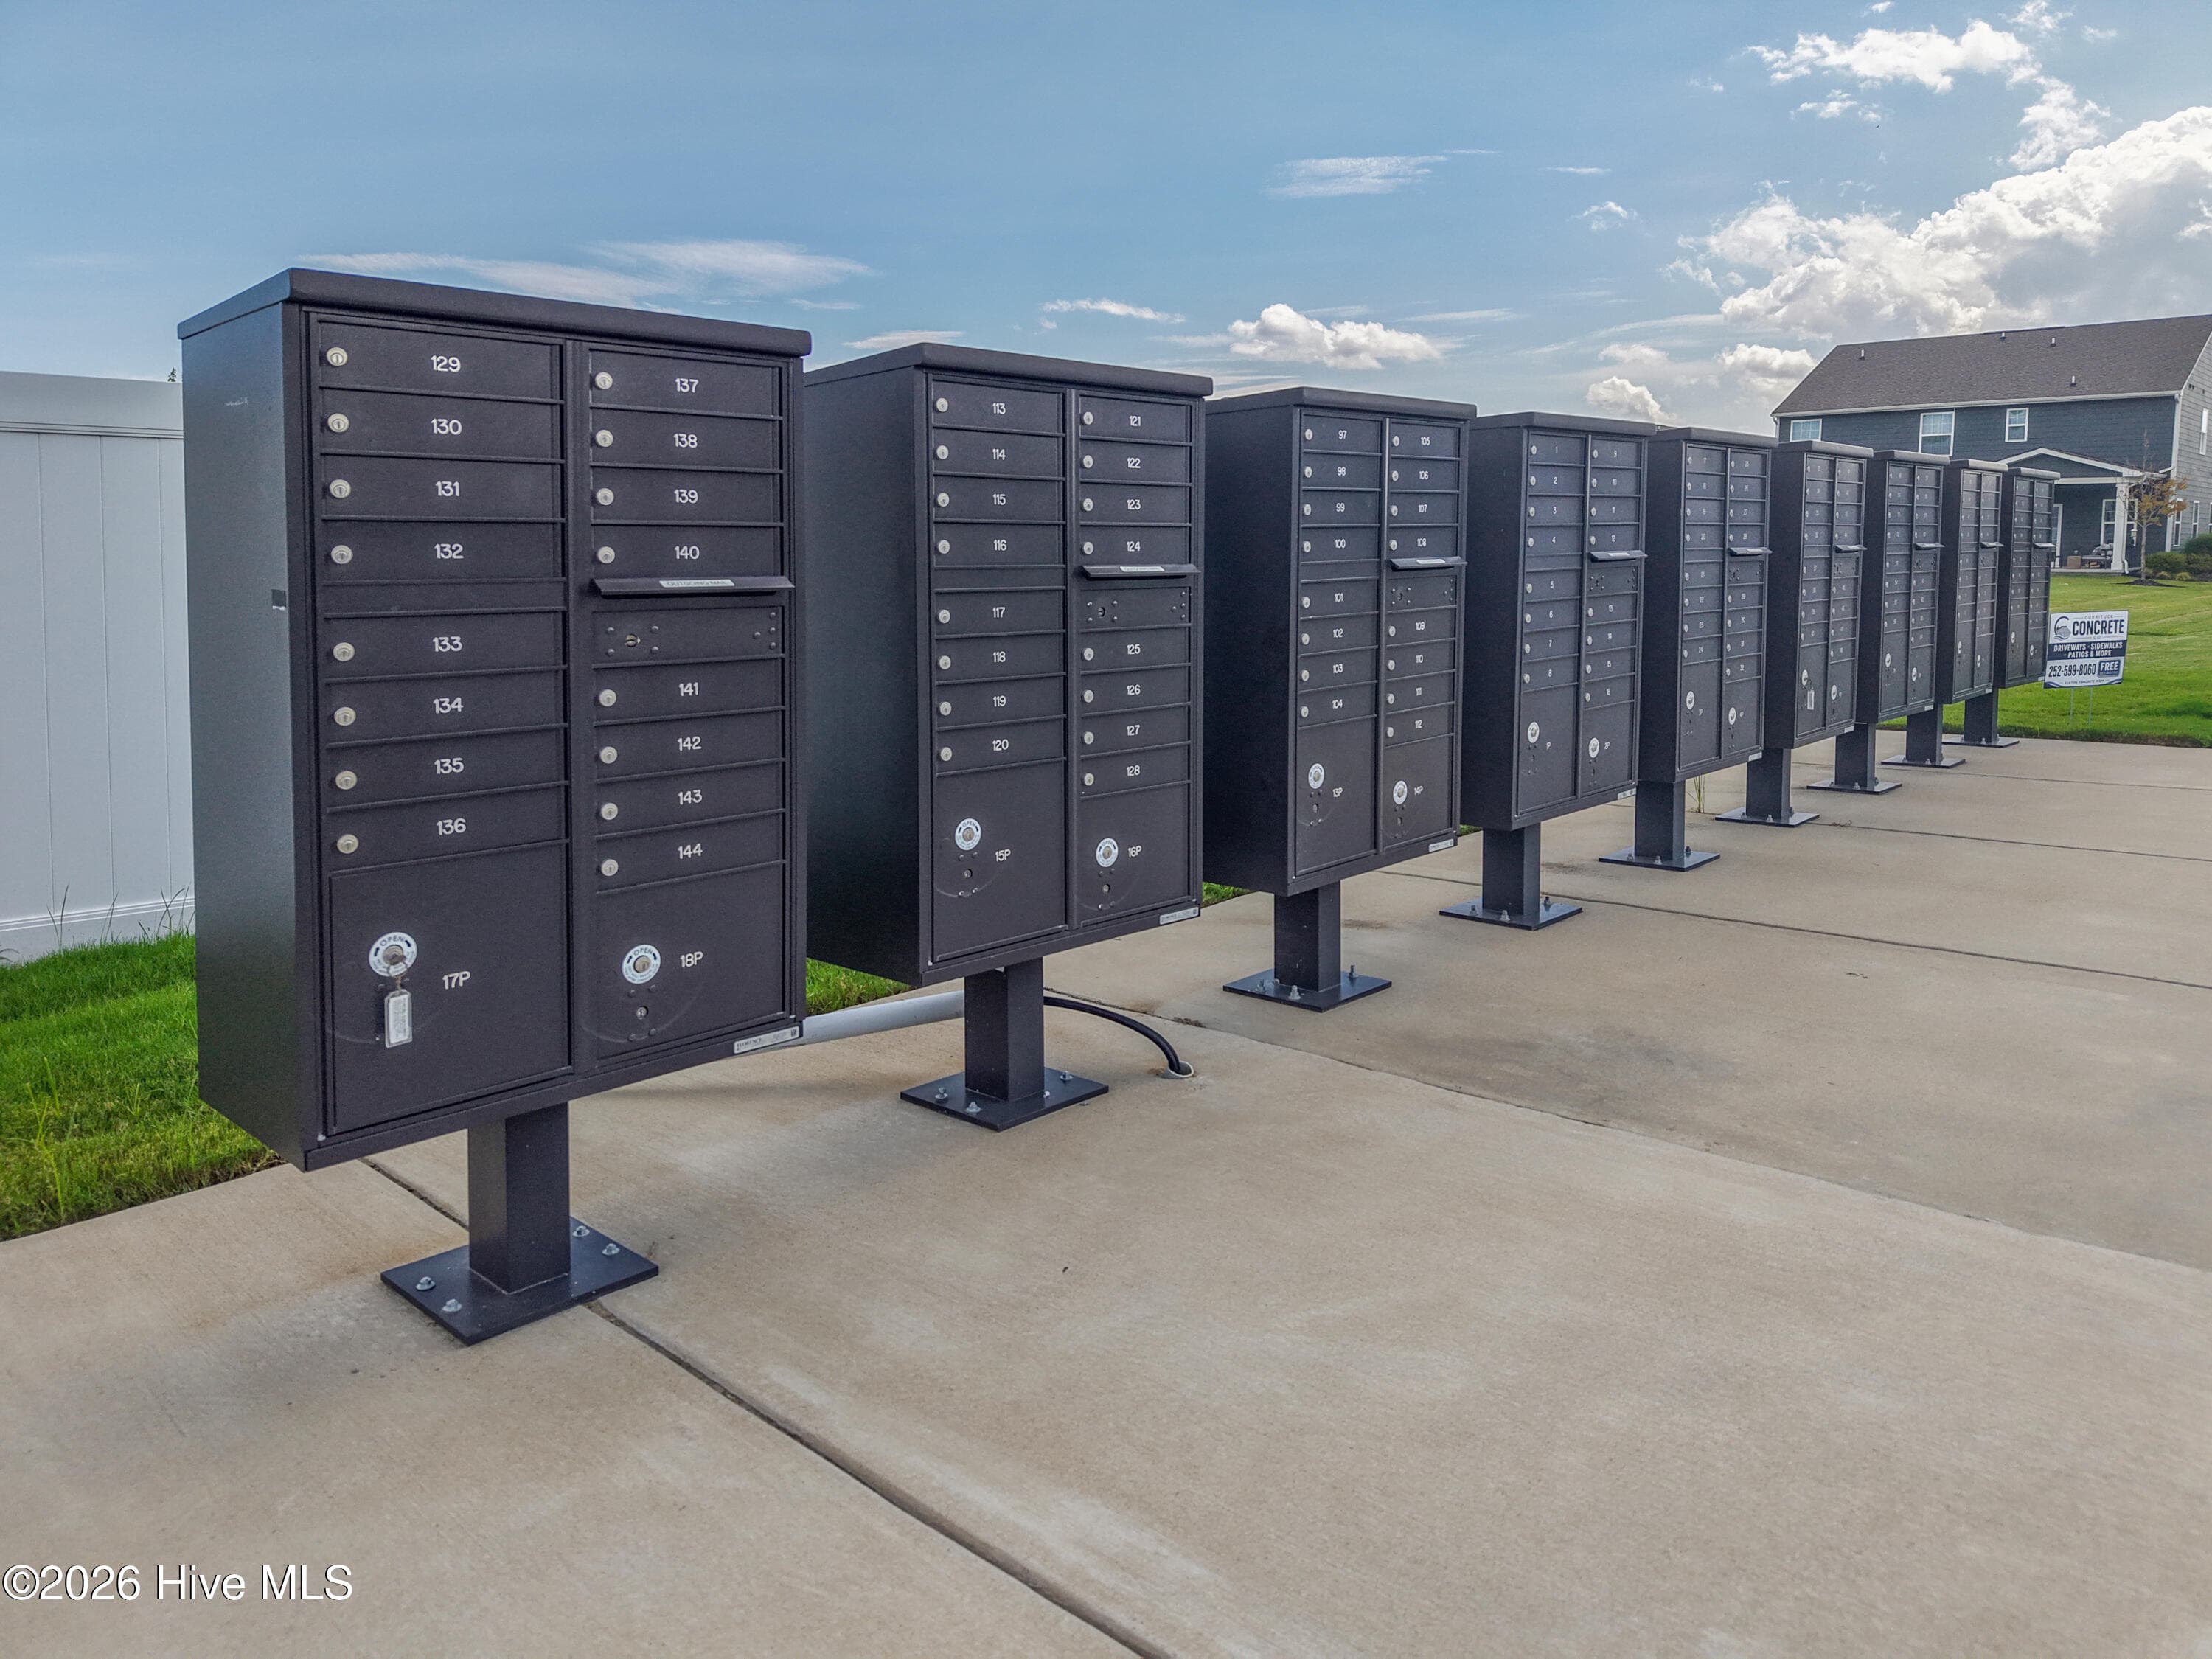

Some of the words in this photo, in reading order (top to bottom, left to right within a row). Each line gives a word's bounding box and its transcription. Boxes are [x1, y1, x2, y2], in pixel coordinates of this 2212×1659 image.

[431, 355, 461, 372] 129
[675, 378, 699, 393] 137
[992, 402, 1006, 415] 113
[431, 418, 462, 435] 130
[1129, 415, 1141, 427] 121
[1338, 429, 1347, 439] 97
[673, 433, 698, 448] 138
[1420, 437, 1430, 446] 105
[992, 448, 1006, 461] 114
[1127, 457, 1141, 469] 122
[1337, 466, 1346, 476] 98
[1419, 470, 1429, 480] 106
[435, 481, 460, 497] 131
[674, 489, 698, 504] 139
[992, 493, 1006, 506] 115
[1127, 498, 1141, 510] 123
[1335, 502, 1346, 512] 99
[1418, 504, 1428, 513] 107
[993, 539, 1007, 552] 116
[1126, 540, 1141, 552] 124
[1335, 538, 1346, 549] 100
[1416, 538, 1427, 547] 108
[434, 543, 464, 560] 132
[674, 546, 700, 560] 140
[1334, 593, 1343, 602] 101
[992, 606, 1006, 619] 117
[1415, 621, 1425, 630] 109
[2072, 619, 2124, 636] CONCRETE
[1332, 627, 1343, 639] 102
[432, 636, 463, 653] 133
[1126, 643, 1141, 655] 125
[2053, 643, 2087, 652] DRIVEWAYS
[2090, 641, 2123, 650] SIDEWALKS
[992, 651, 1006, 663] 118
[1415, 654, 1424, 664] 110
[2067, 650, 2089, 658] PATIOS
[1332, 663, 1343, 674] 103
[2048, 663, 2096, 678] 252-599-8060
[2100, 661, 2119, 672] FREE
[678, 682, 699, 697] 141
[1126, 684, 1141, 696] 126
[433, 697, 464, 714] 134
[992, 695, 1006, 707] 119
[1332, 699, 1343, 709] 104
[1126, 724, 1141, 736] 127
[1414, 719, 1422, 729] 112
[677, 736, 702, 751] 142
[992, 739, 1009, 751] 120
[434, 757, 465, 774] 135
[1126, 765, 1141, 776] 128
[678, 789, 703, 805] 143
[436, 818, 467, 835] 136
[678, 843, 703, 860] 144
[995, 849, 1012, 862] 15P
[1127, 845, 1142, 858] 16P
[380, 934, 405, 947] OPEN
[633, 947, 654, 956] OPEN
[680, 951, 703, 968] 18P
[442, 970, 471, 990] 17P
